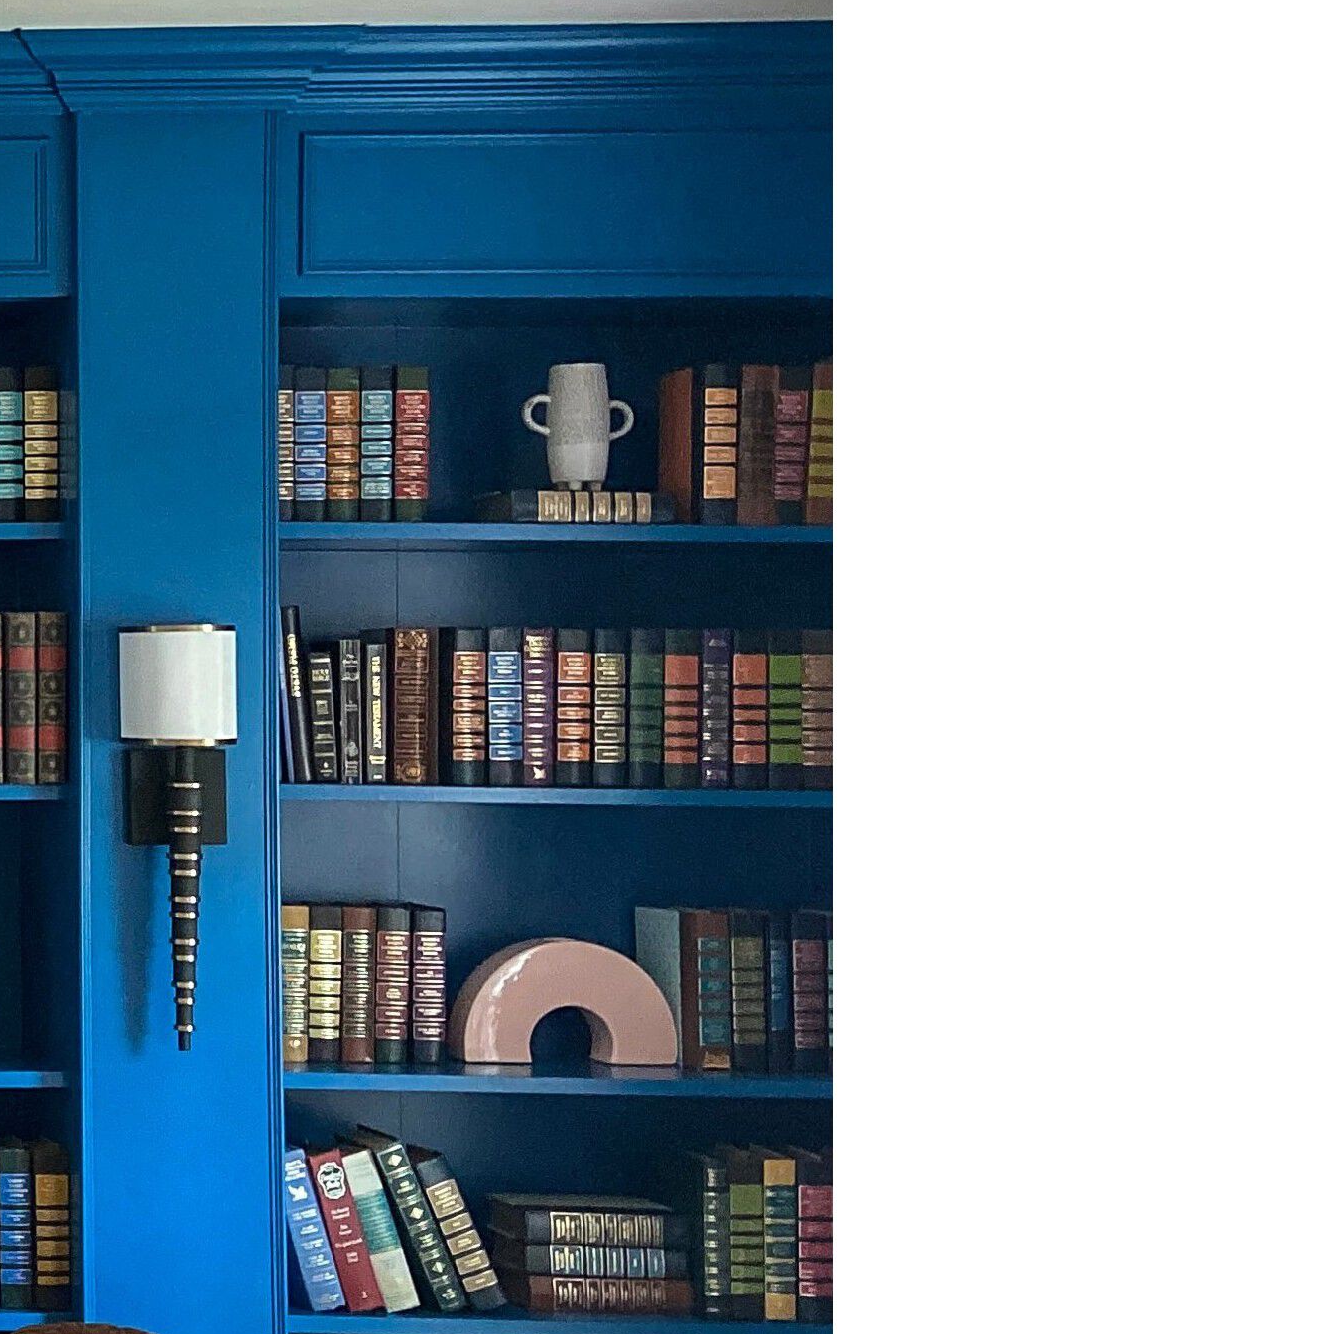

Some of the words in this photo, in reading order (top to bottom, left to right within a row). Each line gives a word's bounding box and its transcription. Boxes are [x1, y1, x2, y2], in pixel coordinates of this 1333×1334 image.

[370, 655, 380, 673] THE
[371, 675, 380, 696] NEW
[371, 699, 381, 748] TESTAMENT
